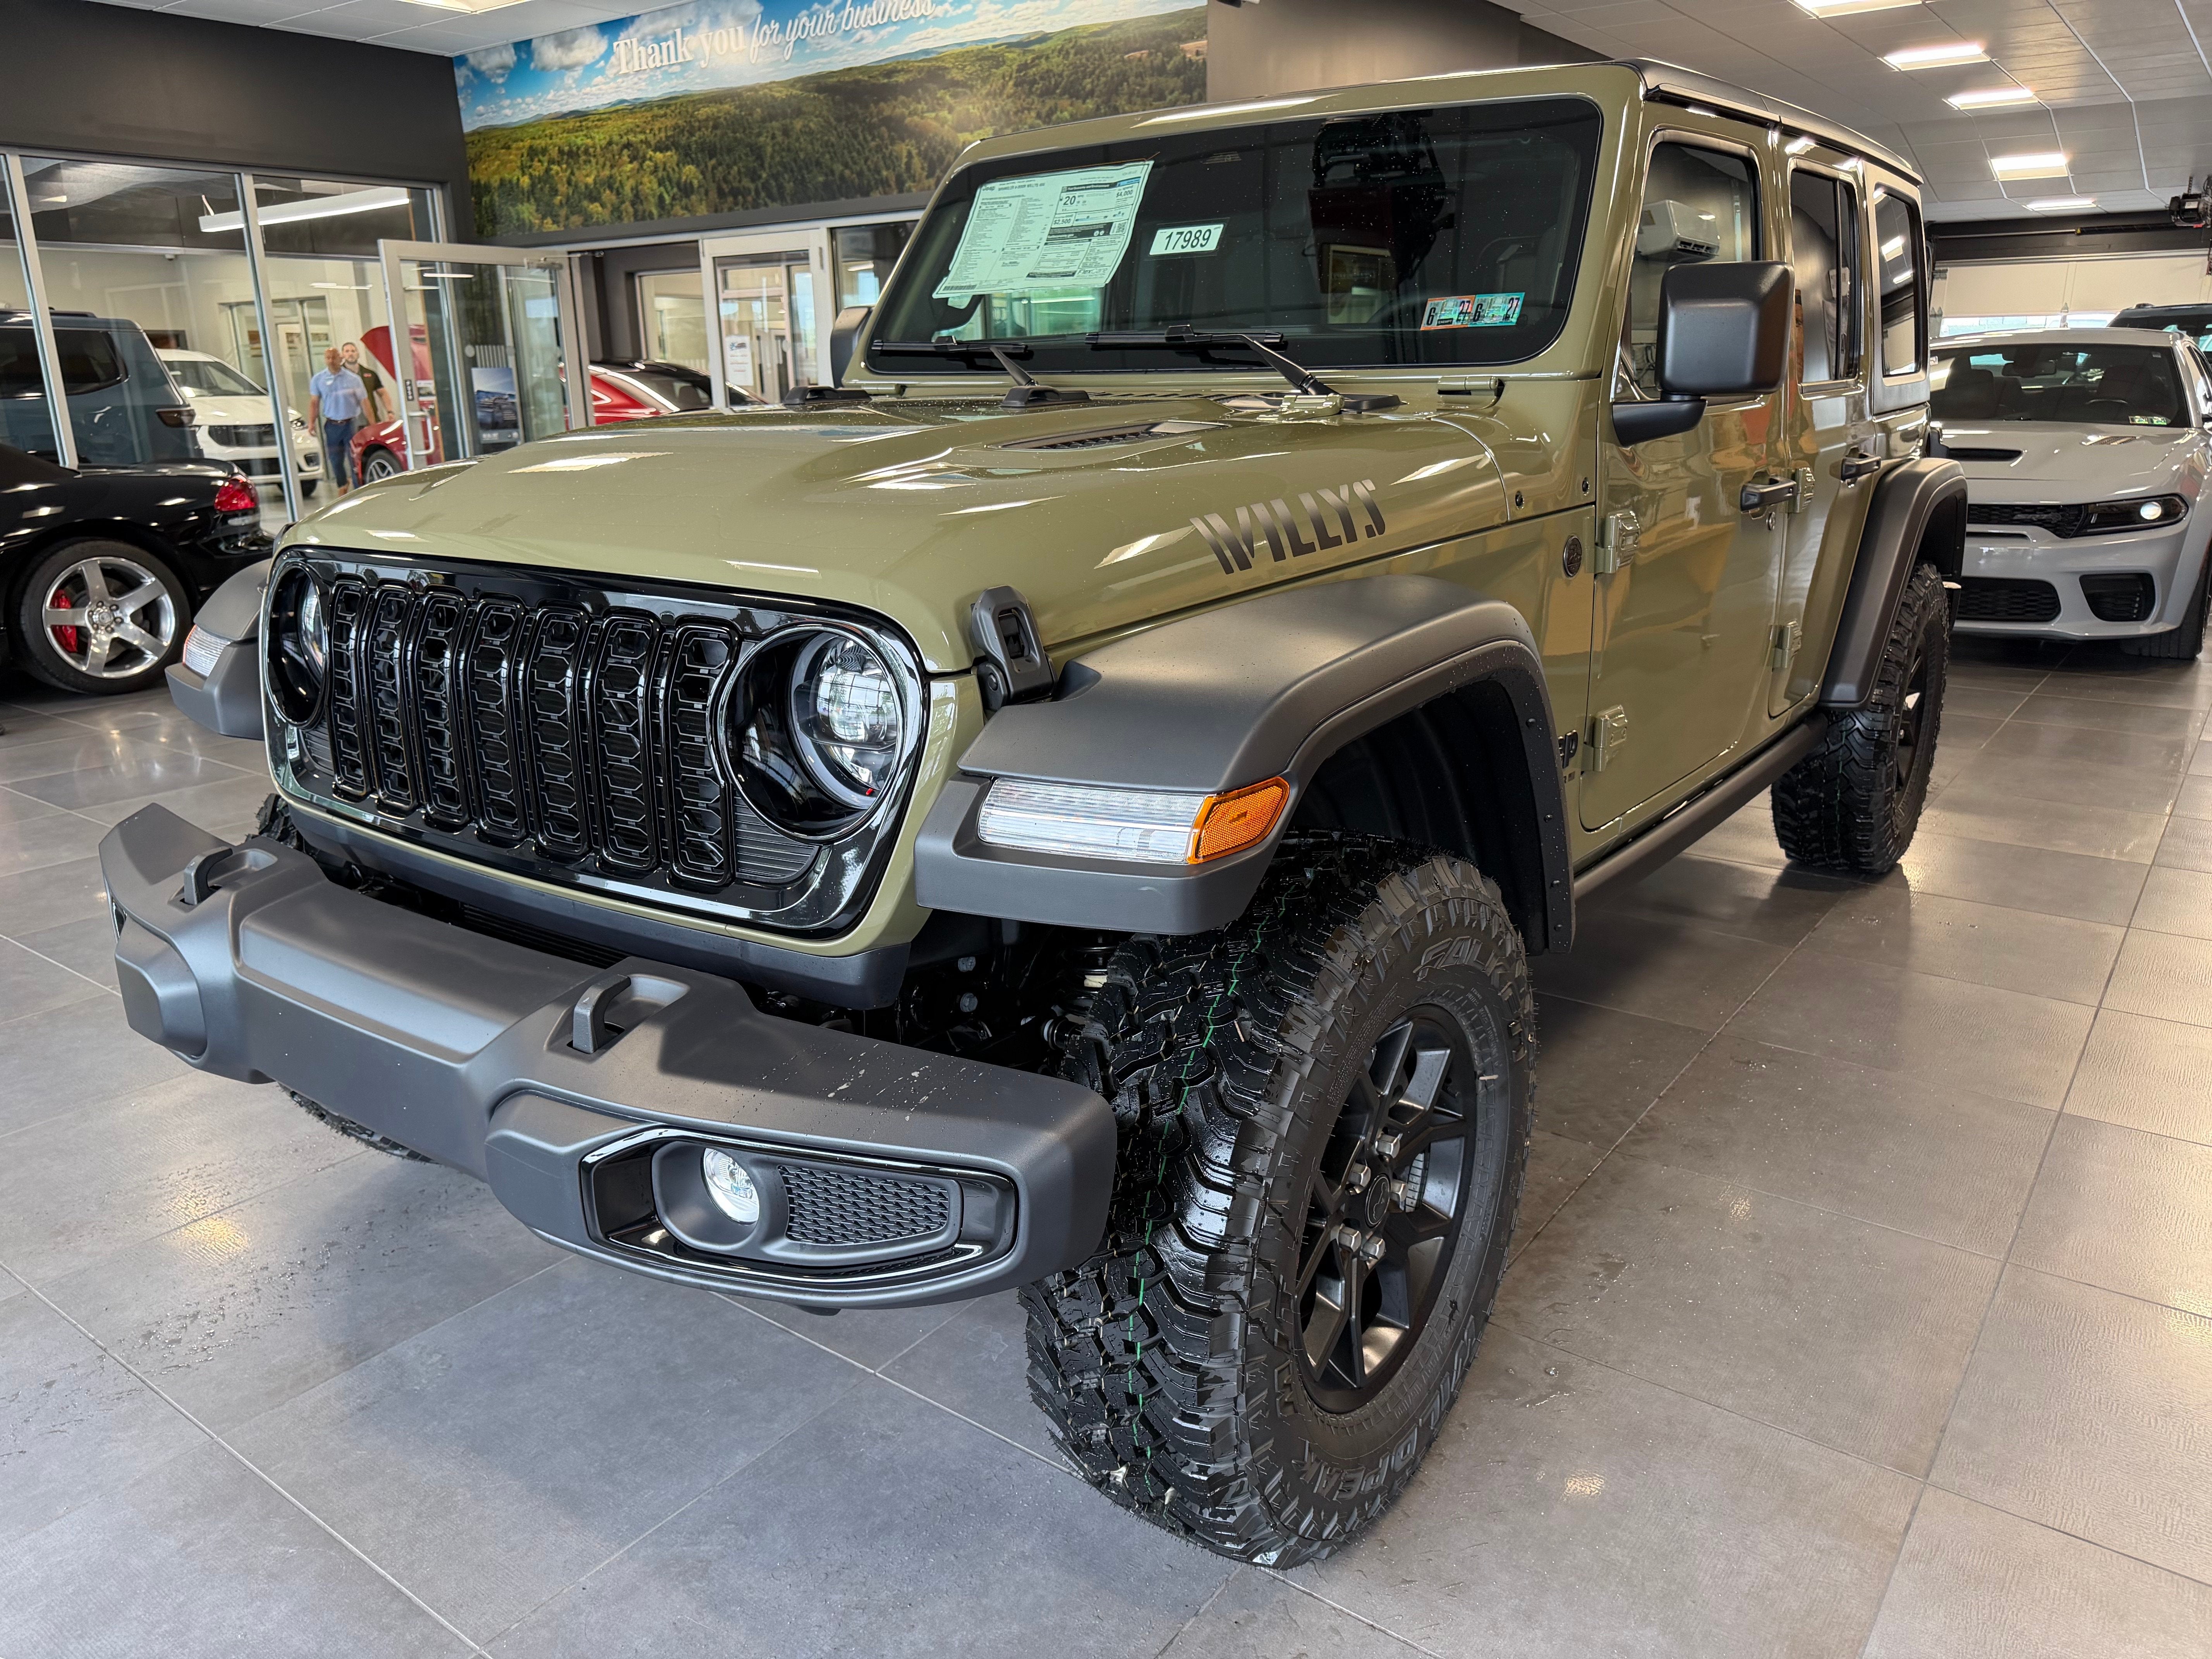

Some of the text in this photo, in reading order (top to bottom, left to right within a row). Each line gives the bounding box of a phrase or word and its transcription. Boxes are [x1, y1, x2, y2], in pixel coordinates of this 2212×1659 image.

[613, 0, 936, 74] Thank you for your business
[1063, 196, 1075, 205] 20
[1165, 229, 1211, 250] 17989
[1426, 307, 1436, 326] 6
[1473, 297, 1520, 322] 6 27
[1190, 479, 1385, 575] WILLYS
